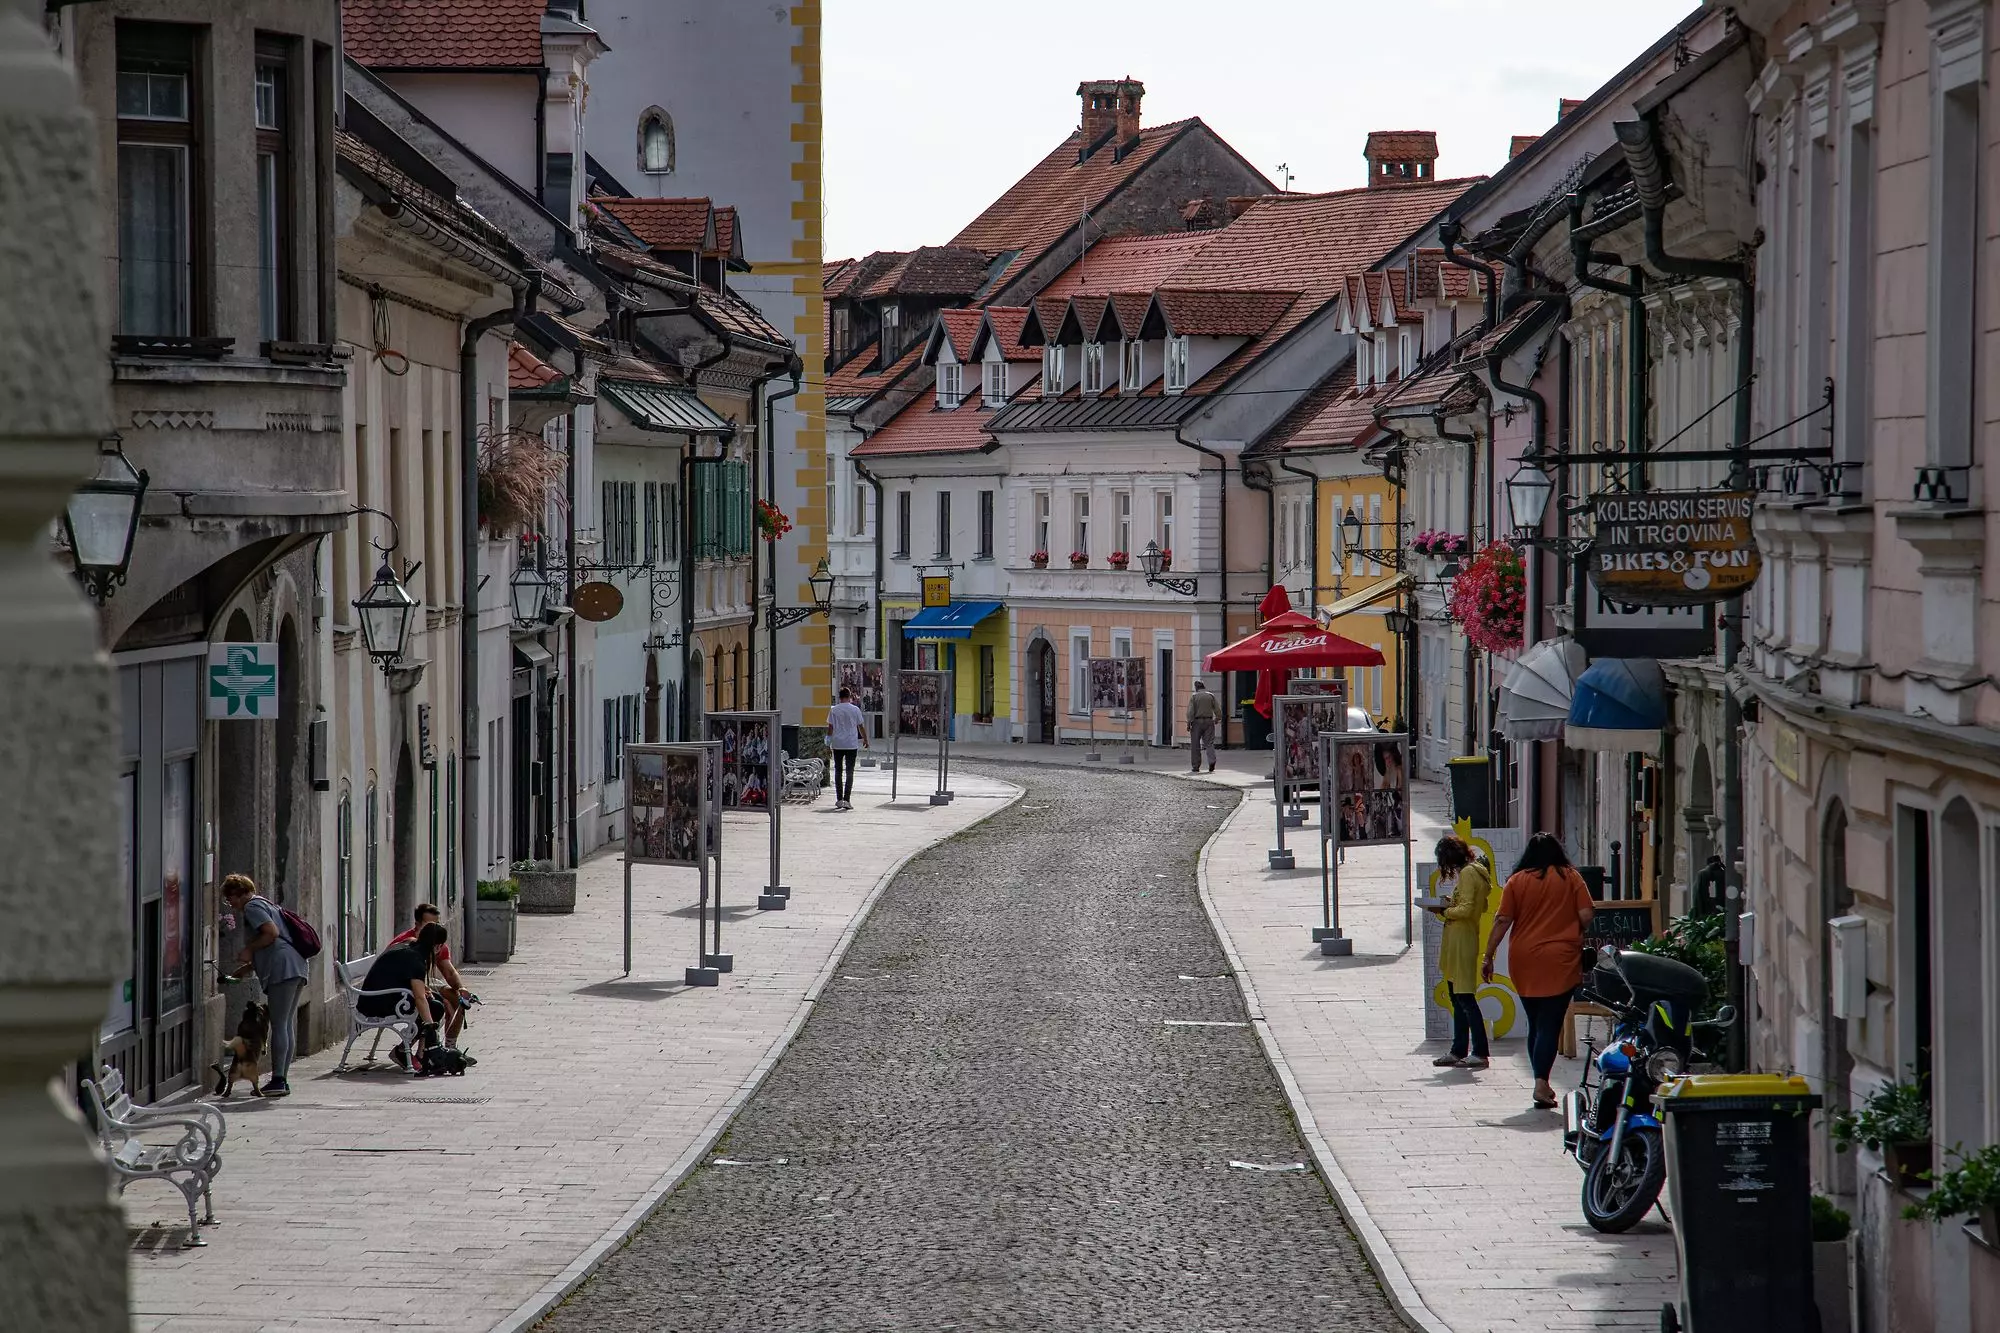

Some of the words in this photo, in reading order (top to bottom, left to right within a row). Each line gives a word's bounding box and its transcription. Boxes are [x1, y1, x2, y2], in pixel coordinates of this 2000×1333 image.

[1597, 499, 1694, 521] KOLESARSKI
[1698, 497, 1751, 519] SERVIS
[1611, 526, 1629, 544] IN
[1634, 523, 1736, 544] TRGOVINA
[1260, 634, 1327, 653] Union
[1613, 911, 1642, 934] ŠALI
